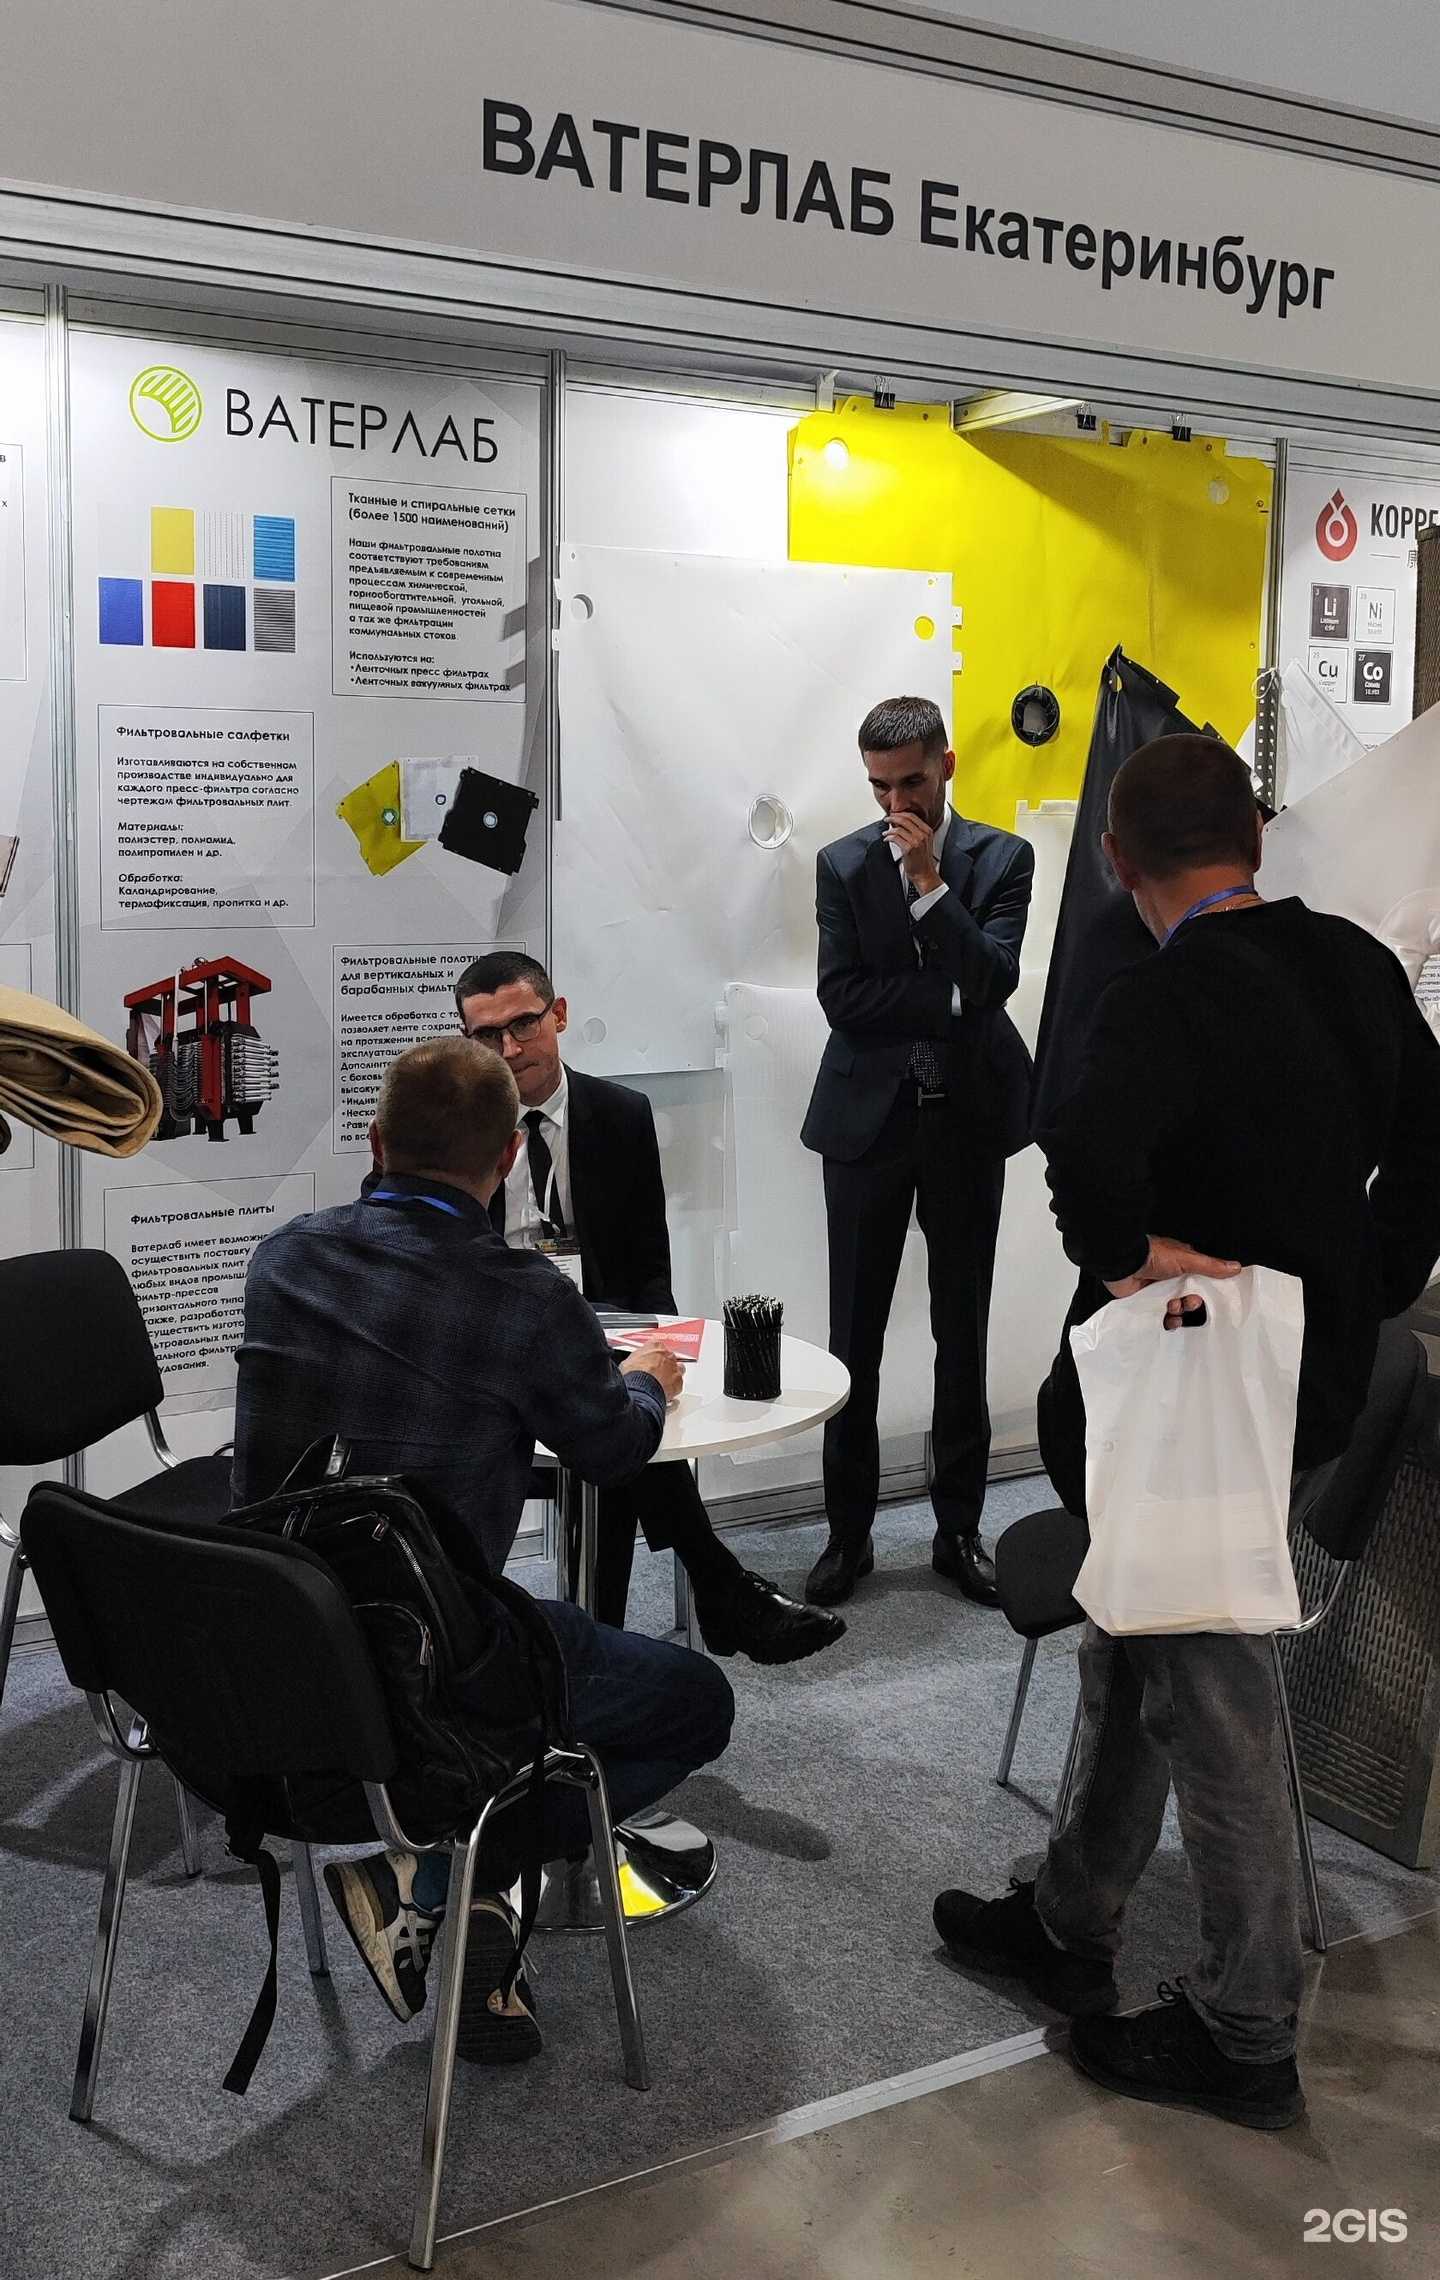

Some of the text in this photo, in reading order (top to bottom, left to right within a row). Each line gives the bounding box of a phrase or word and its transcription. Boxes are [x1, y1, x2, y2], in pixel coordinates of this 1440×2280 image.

[481, 97, 1336, 318] ВАТЕРЛАБ Екатеринбург
[226, 387, 499, 463] ВАТЕРЛАБ
[349, 492, 516, 517] Тканные и спиральные сетки
[349, 508, 509, 533] (более 1500 наименований)
[349, 538, 501, 558] Наши фильтровальные полотна
[349, 552, 489, 570] соответствуют требованиям
[349, 576, 406, 588] процессам
[437, 570, 503, 583] современным
[349, 601, 486, 618] пищевой промышленностей
[1324, 597, 1336, 616] Li
[1369, 602, 1383, 620] Ni
[358, 616, 375, 624] так
[377, 617, 391, 625] же
[394, 617, 454, 628] фильтрации
[349, 627, 421, 639] коммунальных
[349, 651, 435, 664] Используются на:
[411, 667, 440, 676] пресс
[443, 669, 489, 680] фильтрах
[1319, 660, 1338, 678] Cu
[1363, 662, 1383, 681] Co
[465, 679, 511, 692] фильтрах
[116, 726, 290, 743] Фильтровальные салфетки
[117, 757, 209, 768] Изготавливаются
[228, 758, 297, 770] собственном
[117, 771, 293, 783] производстве индивидуально для
[117, 784, 299, 795] каждого пресс-фильтра согласно
[117, 797, 173, 806] чертежам
[176, 797, 264, 808] фильтровальных
[117, 822, 184, 832] Материалы:
[118, 849, 222, 858] полипропилен и др.
[118, 873, 183, 883] Обработка:
[212, 898, 262, 909] пропитка
[264, 899, 270, 907] и
[273, 899, 289, 909] др.
[340, 955, 482, 967] Фильтровальные полотн
[340, 969, 454, 981] для вертикальных и
[341, 984, 415, 996] барабанных
[341, 1013, 383, 1022] Имеется
[385, 1011, 438, 1022] обработка
[341, 1025, 388, 1034] позволяет
[391, 1024, 418, 1033] ленте
[341, 1038, 353, 1047] на
[355, 1035, 414, 1047] протяжении
[341, 1134, 352, 1142] по
[130, 1205, 275, 1224] Фильтровальные плиты
[131, 1240, 182, 1254] Ватерлаб
[184, 1238, 217, 1248] имеет
[131, 1247, 251, 1266] осуществить поставку
[131, 1259, 245, 1279] фильтровальных плит
[169, 1276, 199, 1287] видов
